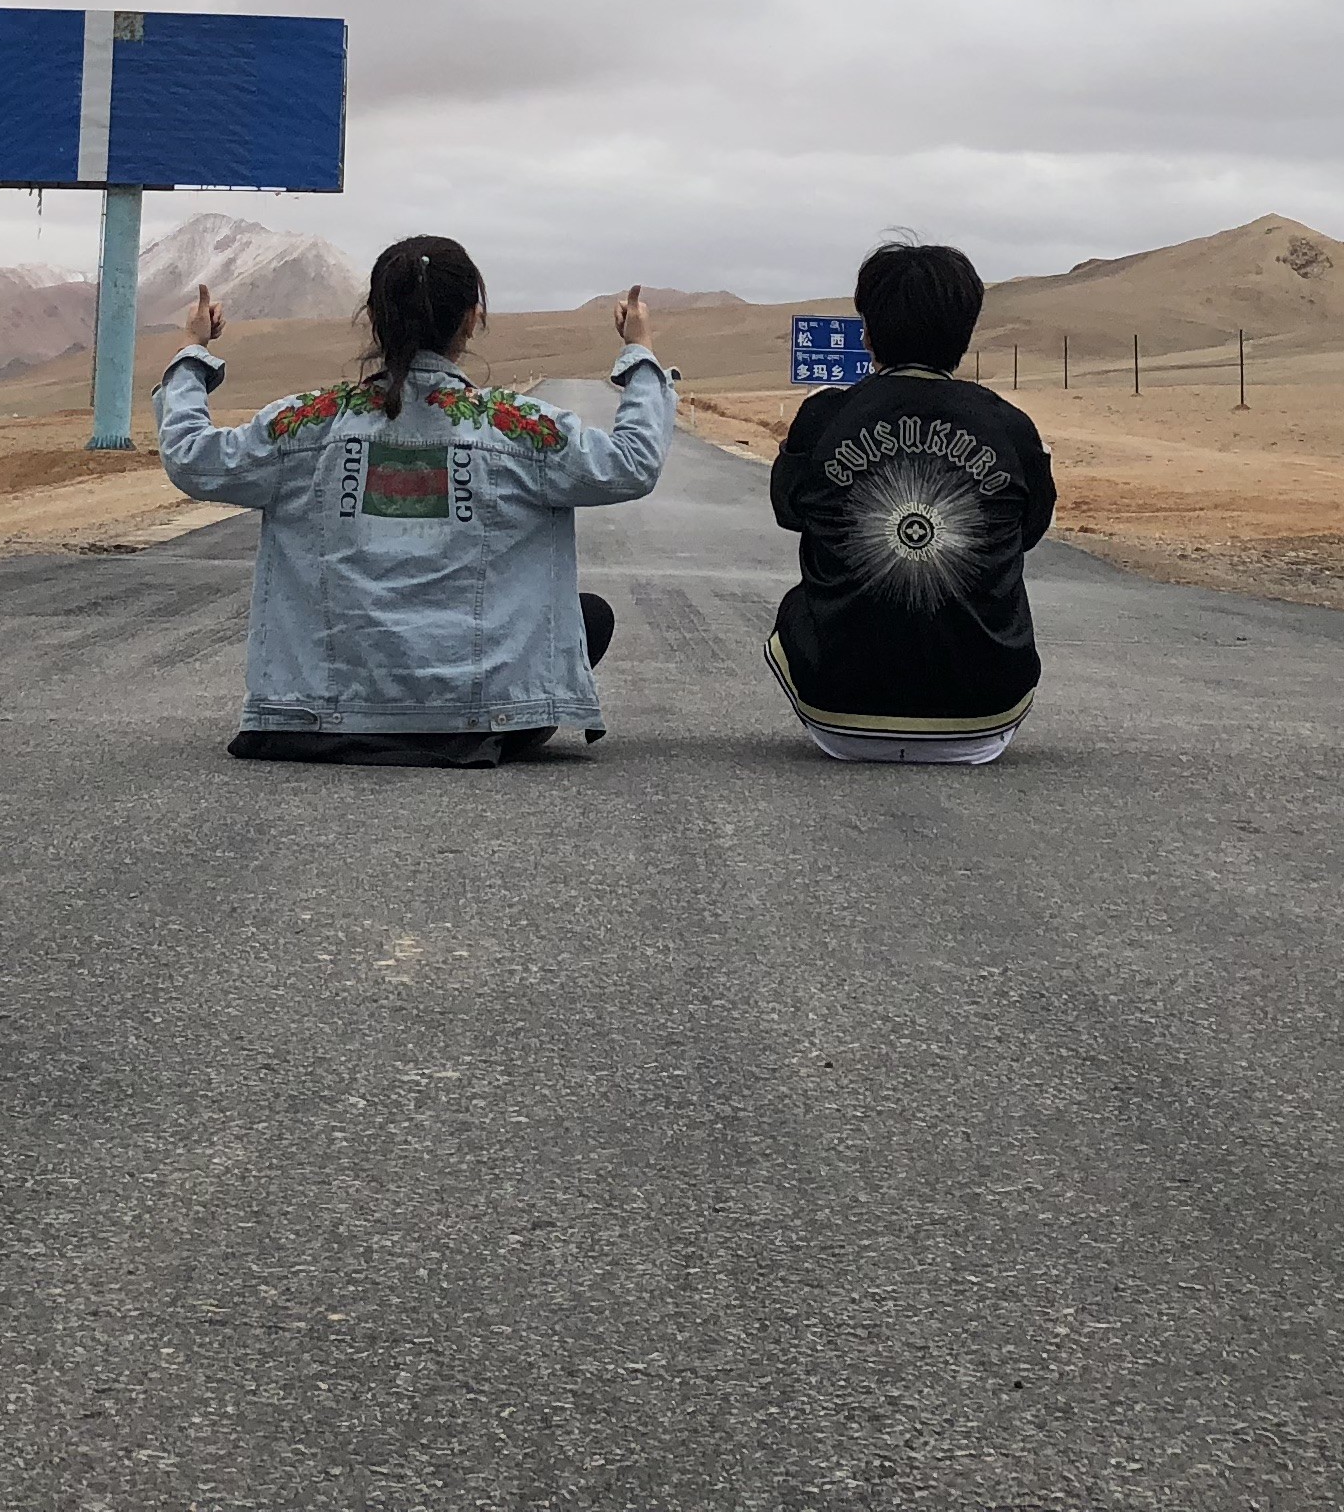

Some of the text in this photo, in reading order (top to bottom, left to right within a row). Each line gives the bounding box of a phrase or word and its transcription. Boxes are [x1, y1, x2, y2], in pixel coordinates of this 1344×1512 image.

[797, 331, 845, 348] 松西
[796, 363, 845, 380] 多玛乡
[339, 436, 363, 519] GUCCI
[452, 443, 473, 523] GUCCI
